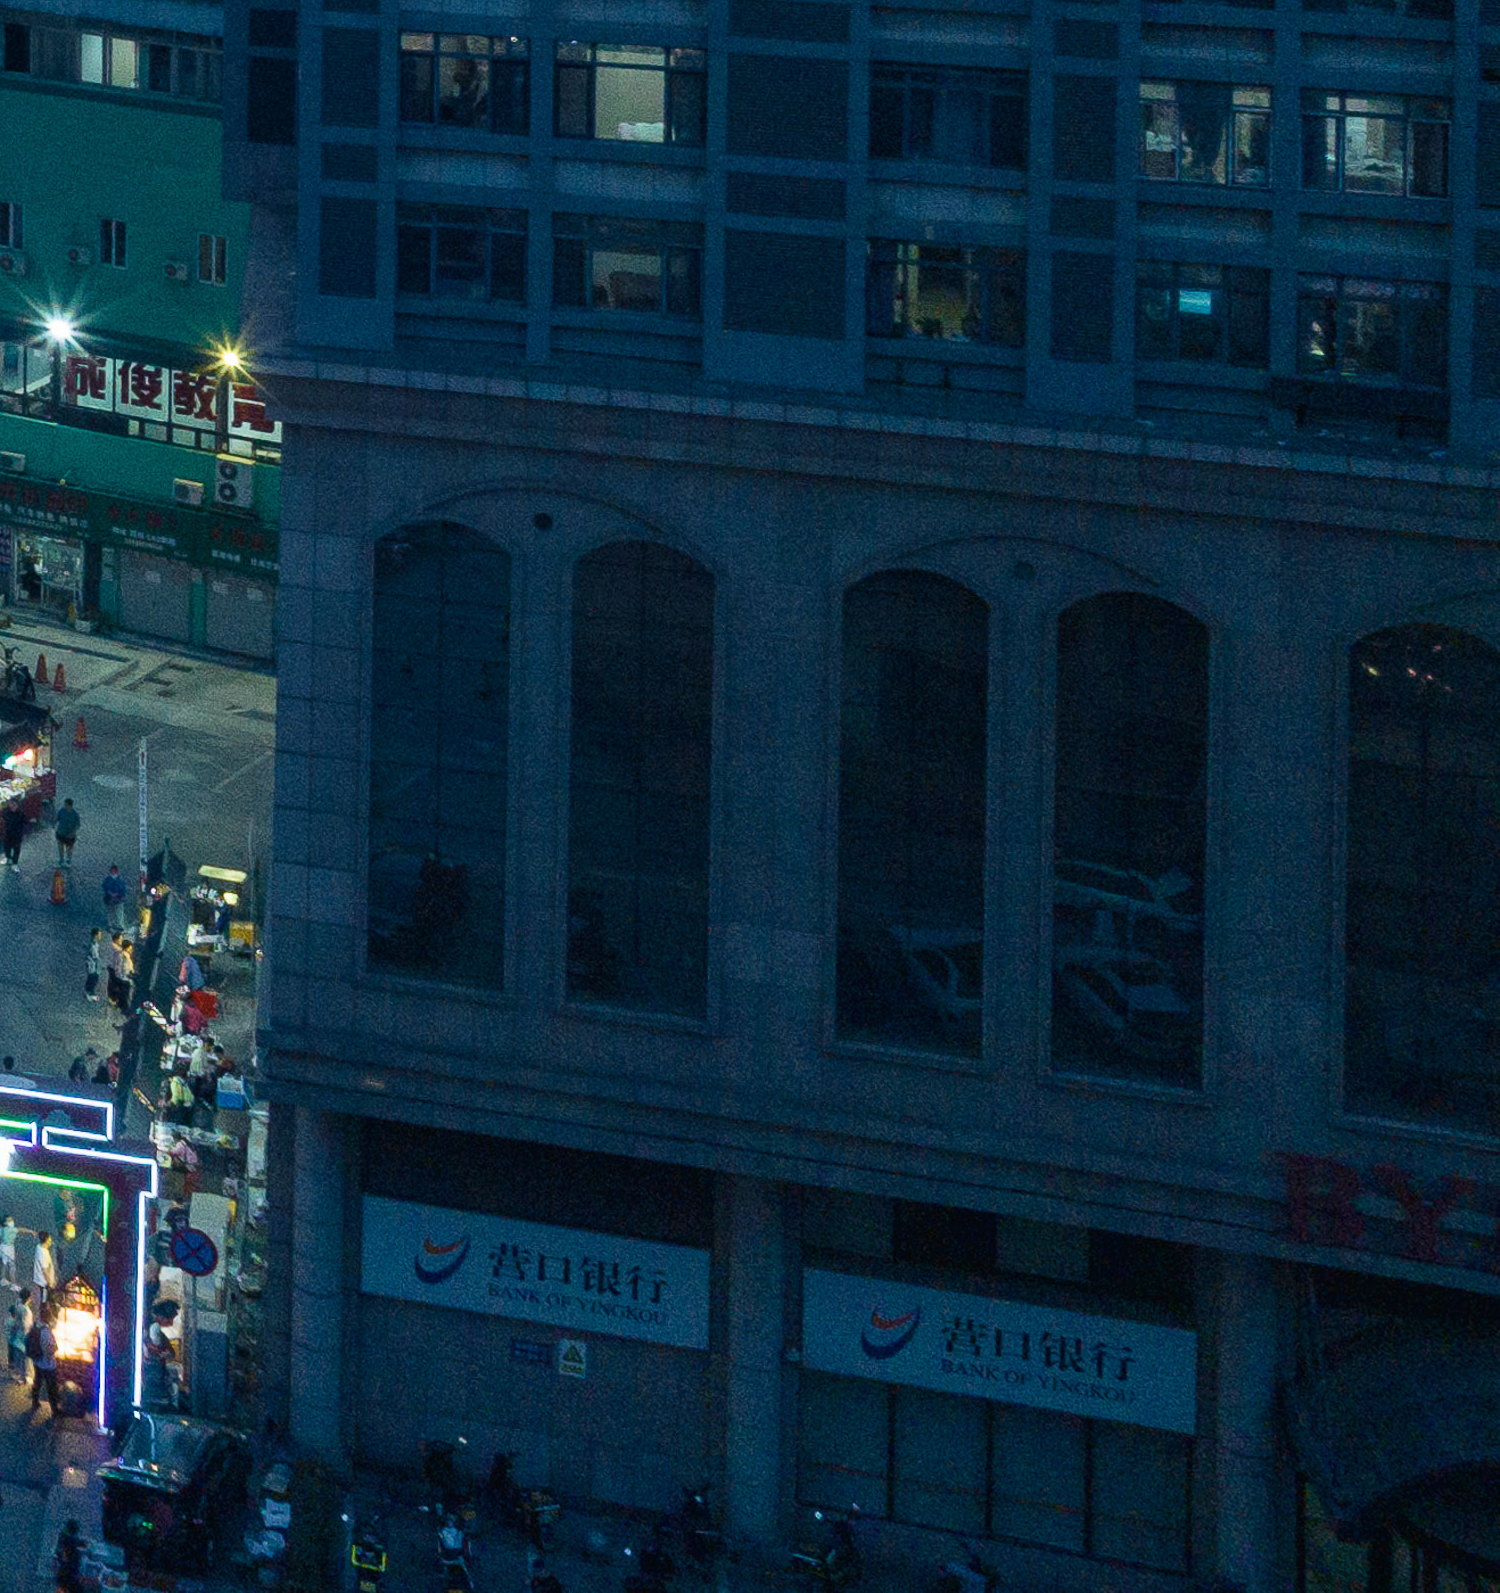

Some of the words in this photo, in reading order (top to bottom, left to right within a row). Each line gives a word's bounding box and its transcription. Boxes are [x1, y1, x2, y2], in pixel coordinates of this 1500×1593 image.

[489, 1241, 667, 1304] 营口银行
[489, 1284, 540, 1304] BANK
[547, 1292, 571, 1309] OF
[578, 1295, 668, 1327] YINGKOU
[942, 1316, 1135, 1381] 营口银行
[942, 1359, 998, 1383] BANK
[1005, 1368, 1031, 1387] OF
[1037, 1372, 1137, 1403] YINGKOU
